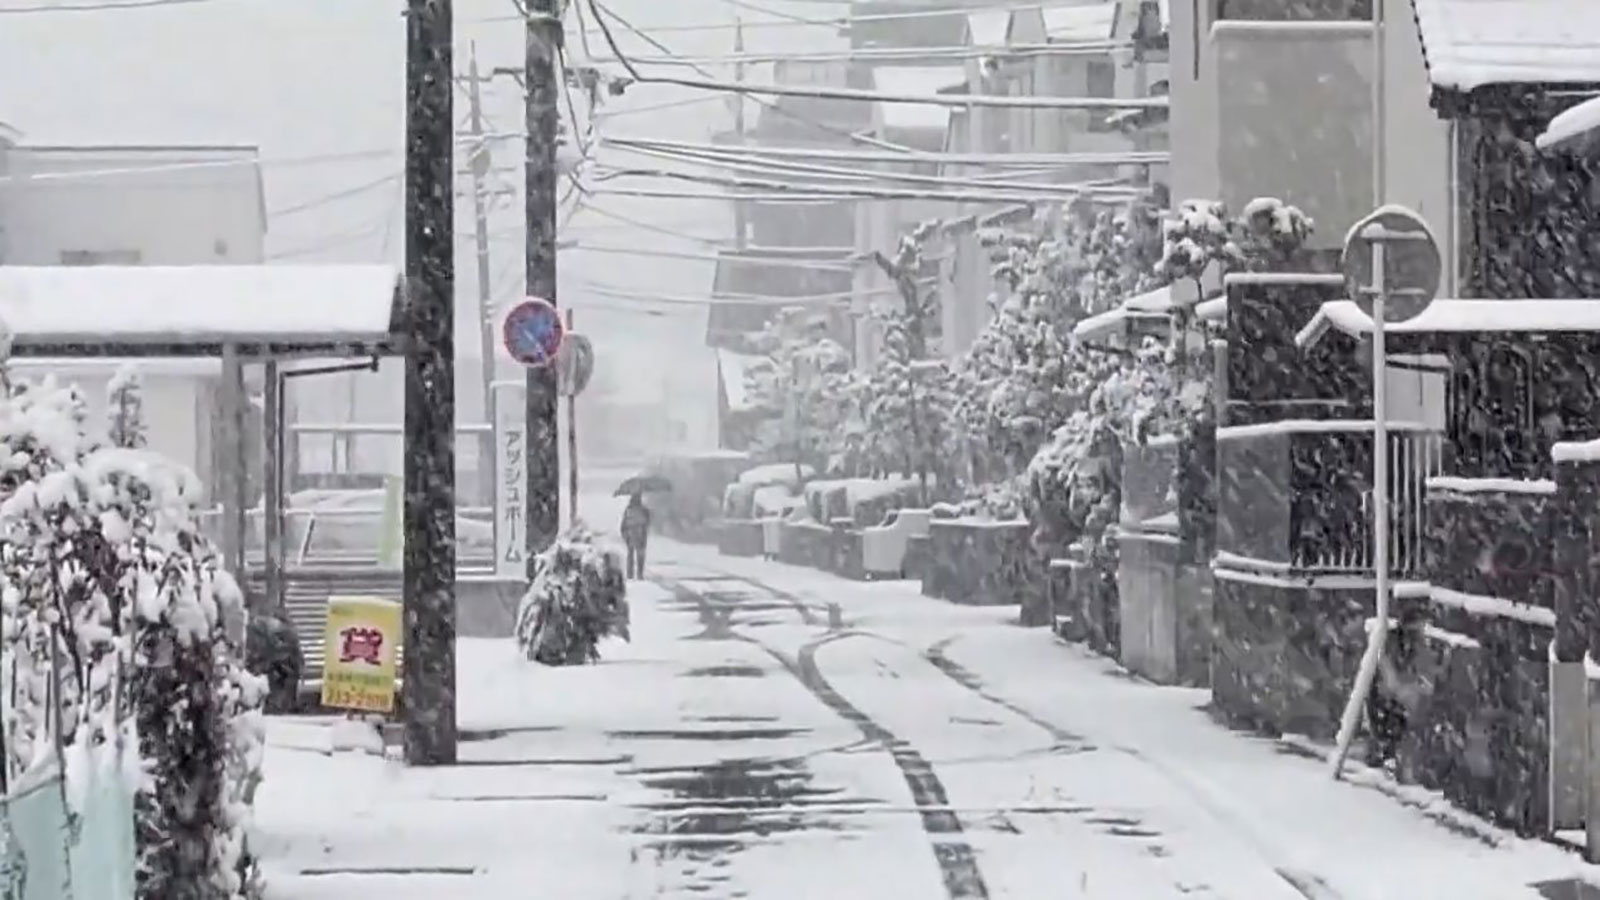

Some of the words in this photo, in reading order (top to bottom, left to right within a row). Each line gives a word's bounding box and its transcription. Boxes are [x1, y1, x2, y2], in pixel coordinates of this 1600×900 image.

[504, 430, 522, 563] アッシュホーム
